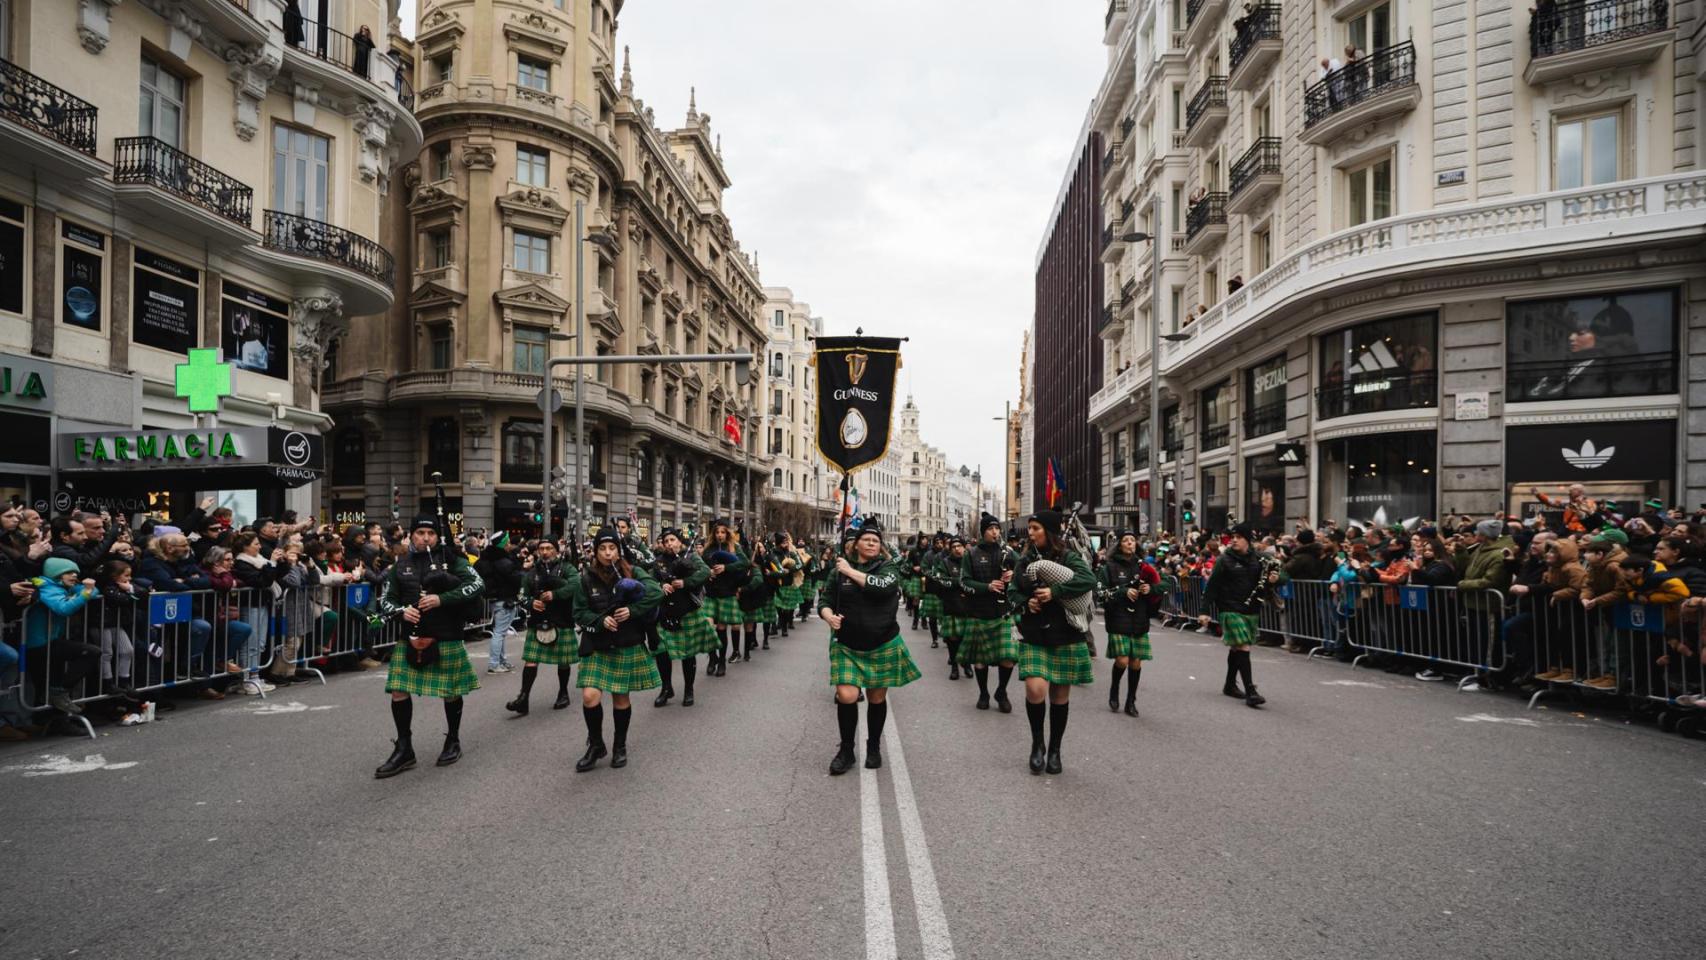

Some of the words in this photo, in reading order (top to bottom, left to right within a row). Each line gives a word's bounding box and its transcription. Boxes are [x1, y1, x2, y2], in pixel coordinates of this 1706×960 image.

[1254, 366, 1288, 395] SPEZIAL
[833, 386, 879, 402] GUINNESS
[74, 432, 240, 461] FARMACIA
[276, 467, 317, 479] FARMACIA
[78, 496, 147, 511] FARMACIA
